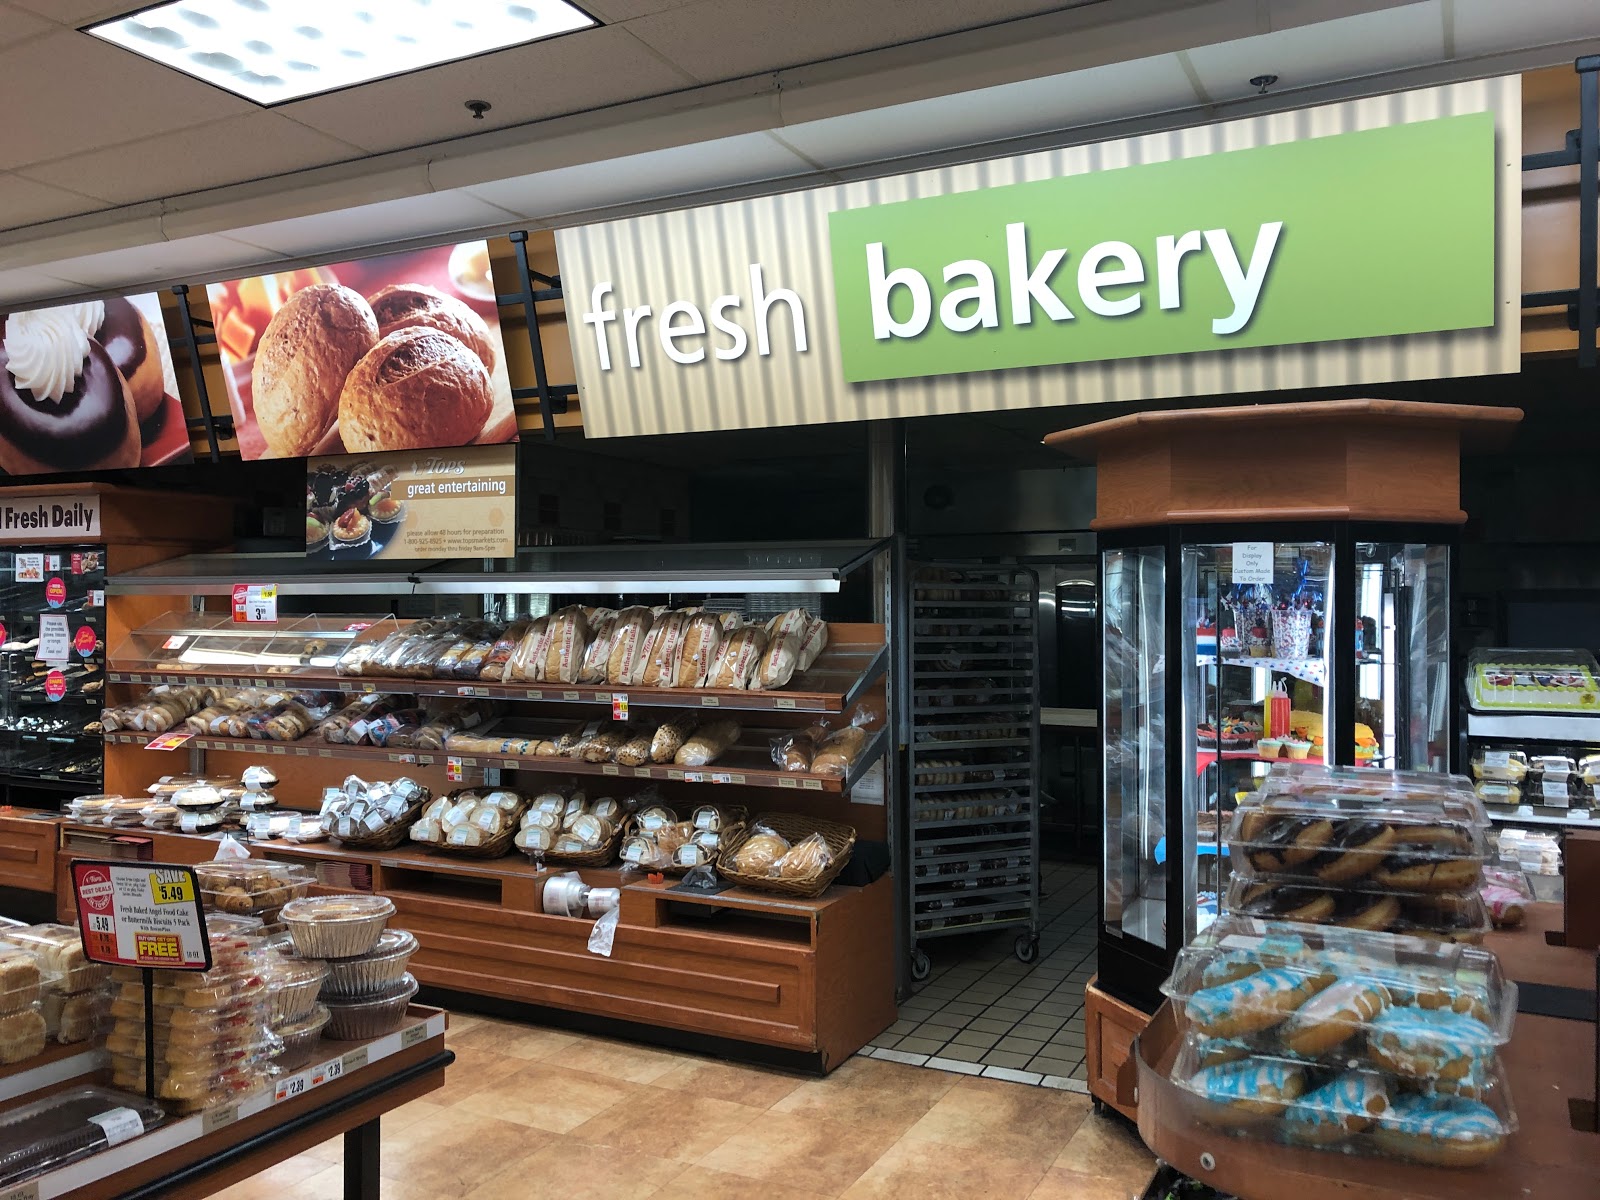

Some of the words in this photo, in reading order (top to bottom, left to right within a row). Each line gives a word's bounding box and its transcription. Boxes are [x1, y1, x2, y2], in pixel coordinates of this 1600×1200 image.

[583, 262, 808, 372] fresh
[866, 221, 1283, 341] bakery
[407, 482, 436, 498] great
[438, 478, 506, 494] entertaining
[5, 505, 48, 529] Fresh
[52, 502, 93, 531] Daily
[447, 537, 509, 545] www.topsmarkets.com
[463, 528, 471, 536] for
[472, 528, 505, 537] preparation
[458, 545, 473, 553] friday
[565, 615, 575, 635] Italian
[667, 622, 678, 643] Italian
[562, 639, 572, 668] Authentic
[622, 644, 633, 677] Authentic
[630, 622, 639, 643] Italian
[699, 644, 707, 677] Authentic
[703, 622, 713, 643] Italian
[662, 645, 673, 677] Authentic
[736, 648, 748, 679] Authentic
[155, 868, 186, 884] SAVE
[82, 887, 95, 895] BEST
[95, 885, 112, 893] DEALS
[120, 905, 132, 913] Fresh
[133, 906, 148, 915] Baked
[149, 907, 162, 917] Angel
[163, 908, 175, 916] Food
[176, 908, 189, 916] Cake
[96, 916, 109, 931] 5.49
[127, 916, 152, 925] Buttermilk
[153, 917, 172, 926] Biscuits
[177, 918, 190, 927] Pack
[138, 941, 179, 957] FREE
